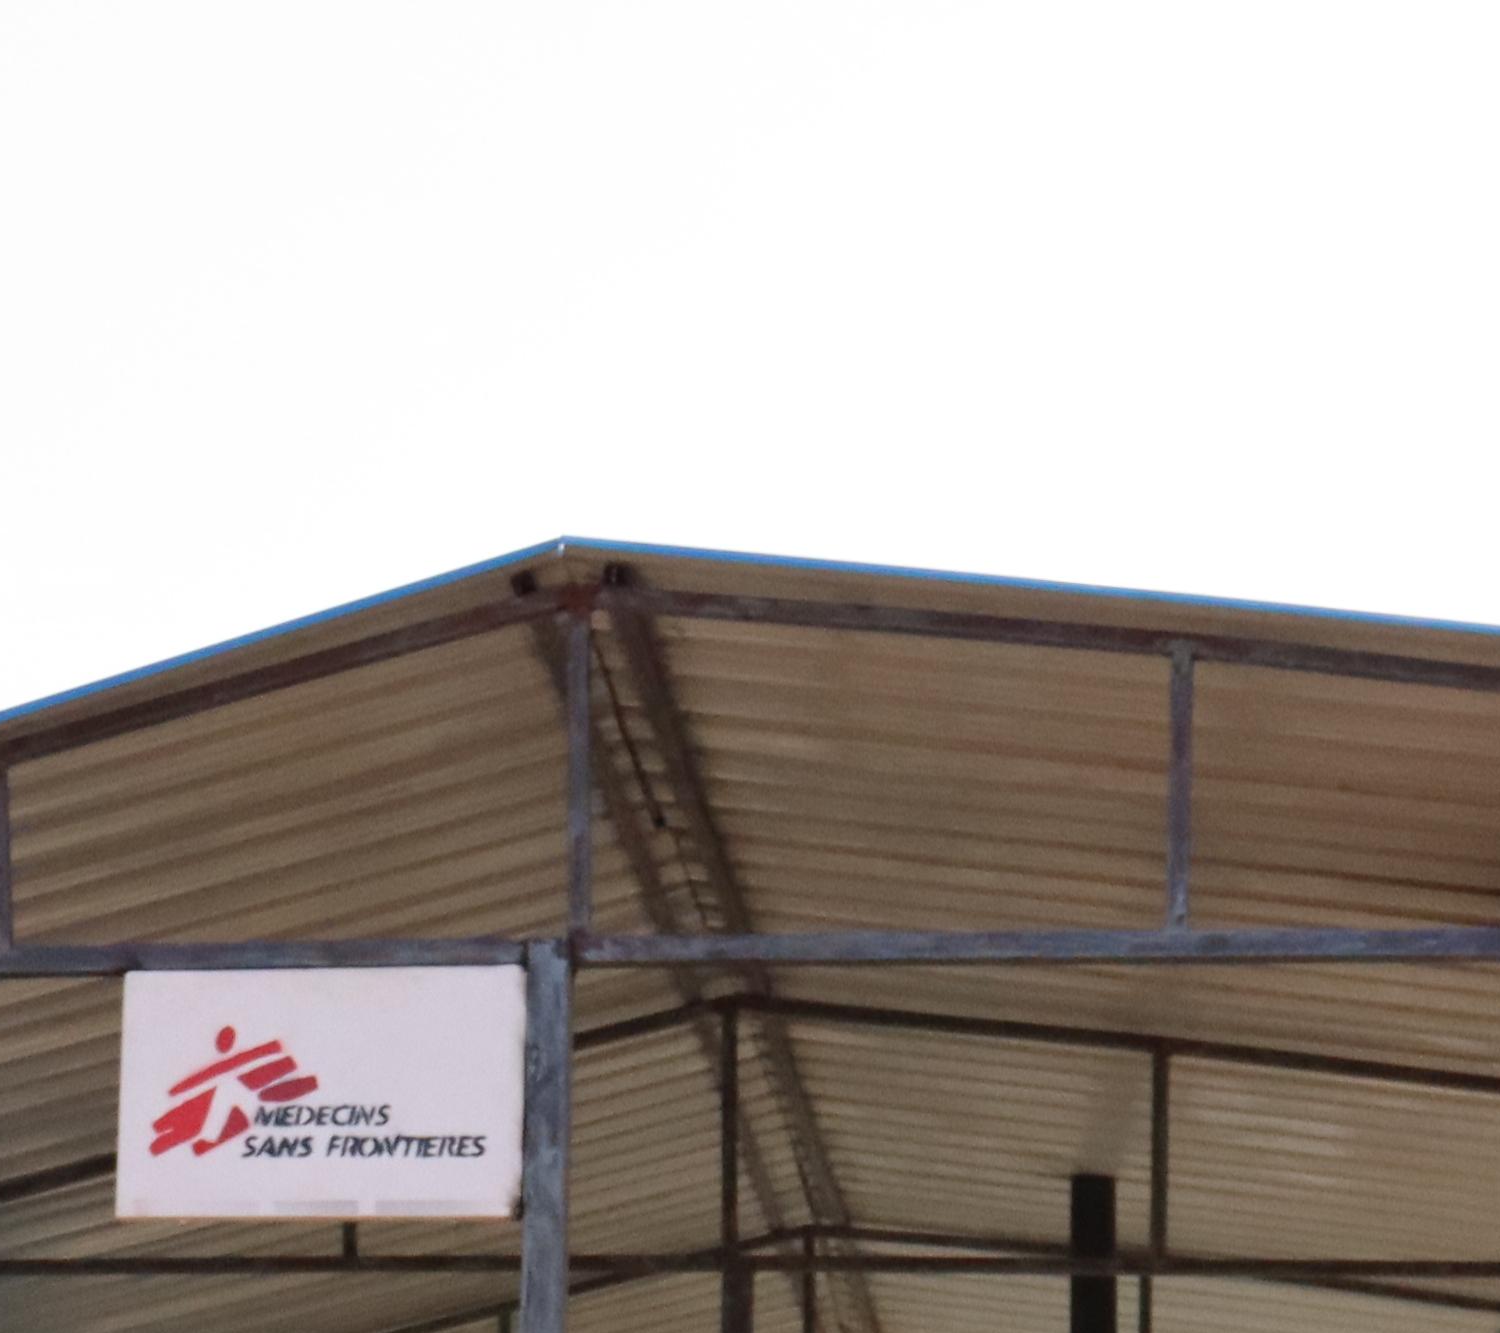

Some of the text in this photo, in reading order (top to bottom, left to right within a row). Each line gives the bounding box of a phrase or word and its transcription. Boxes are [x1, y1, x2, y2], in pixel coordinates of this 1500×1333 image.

[254, 1104, 391, 1126] MEDECINS
[242, 1134, 487, 1158] SANS FRONTIERES
